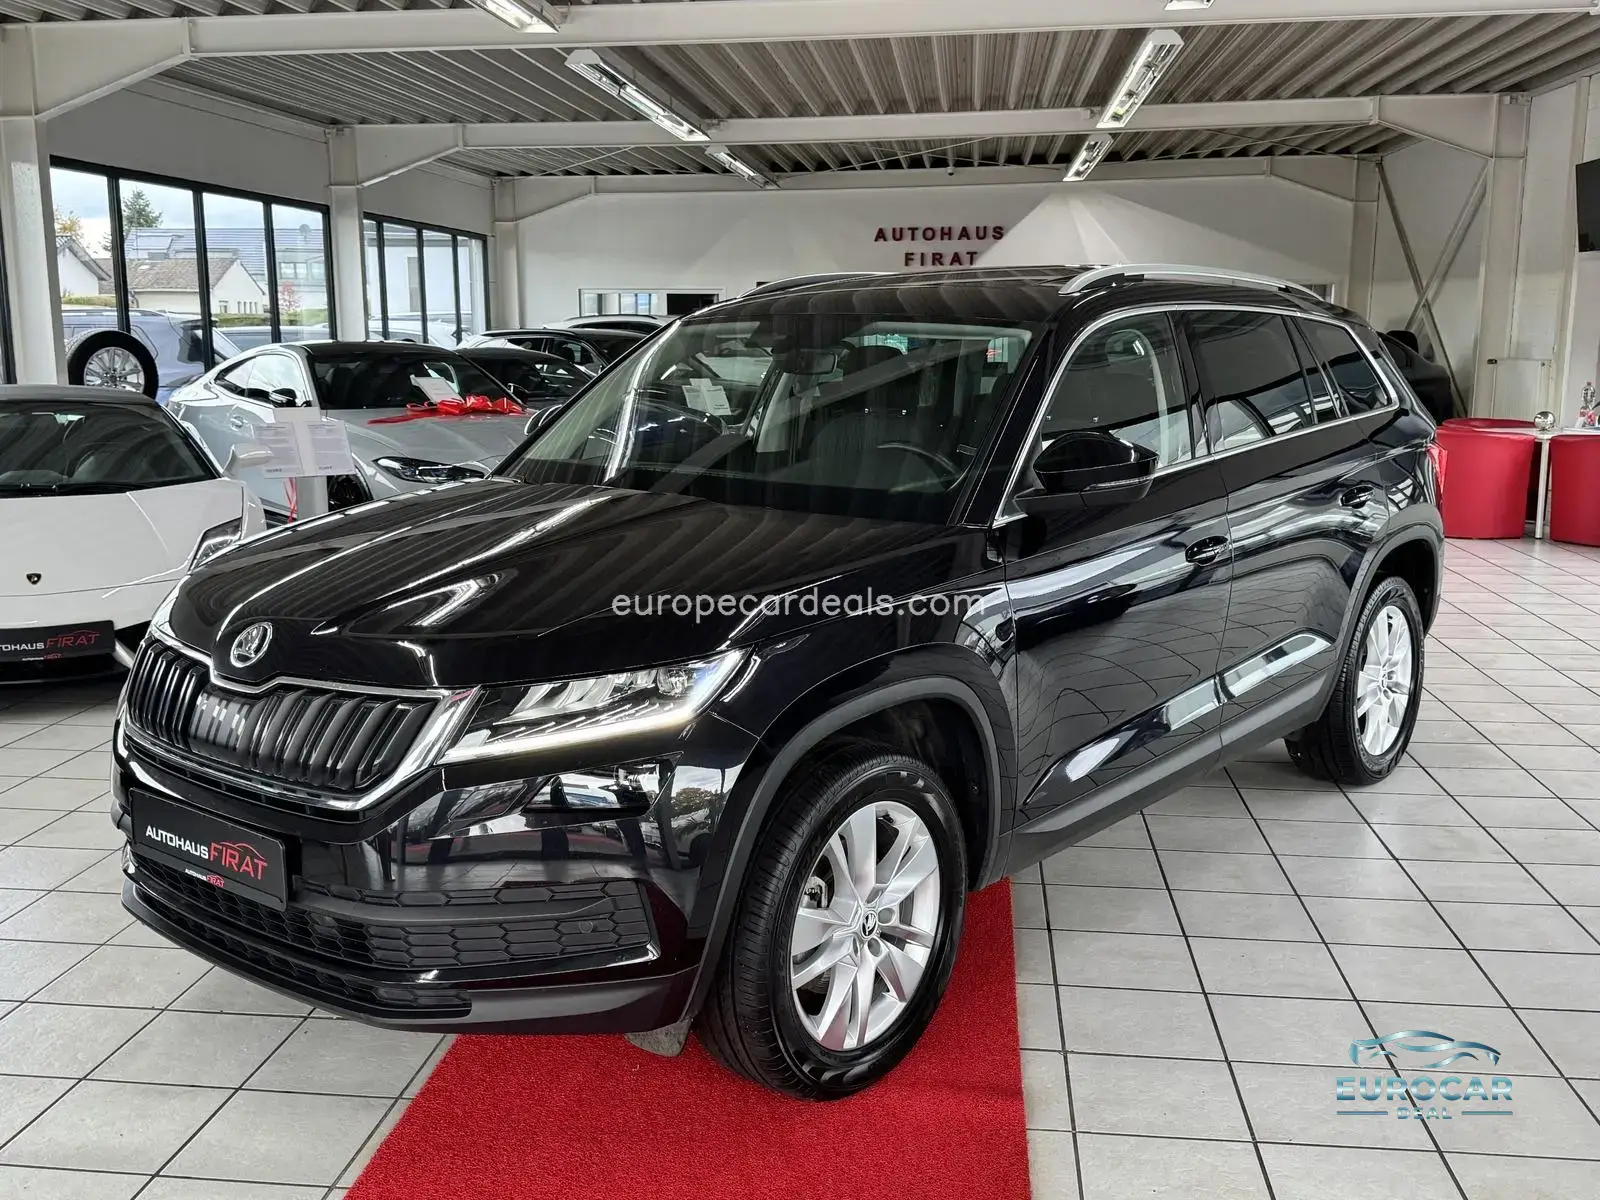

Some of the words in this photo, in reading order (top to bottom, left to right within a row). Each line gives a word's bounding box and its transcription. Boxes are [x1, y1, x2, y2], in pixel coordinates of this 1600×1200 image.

[874, 226, 1005, 242] AUTOHAUS
[904, 251, 978, 267] FIRAT
[45, 632, 101, 649] FIRAT
[145, 825, 209, 860] AUTOHAUS
[210, 841, 268, 881] FIRAT
